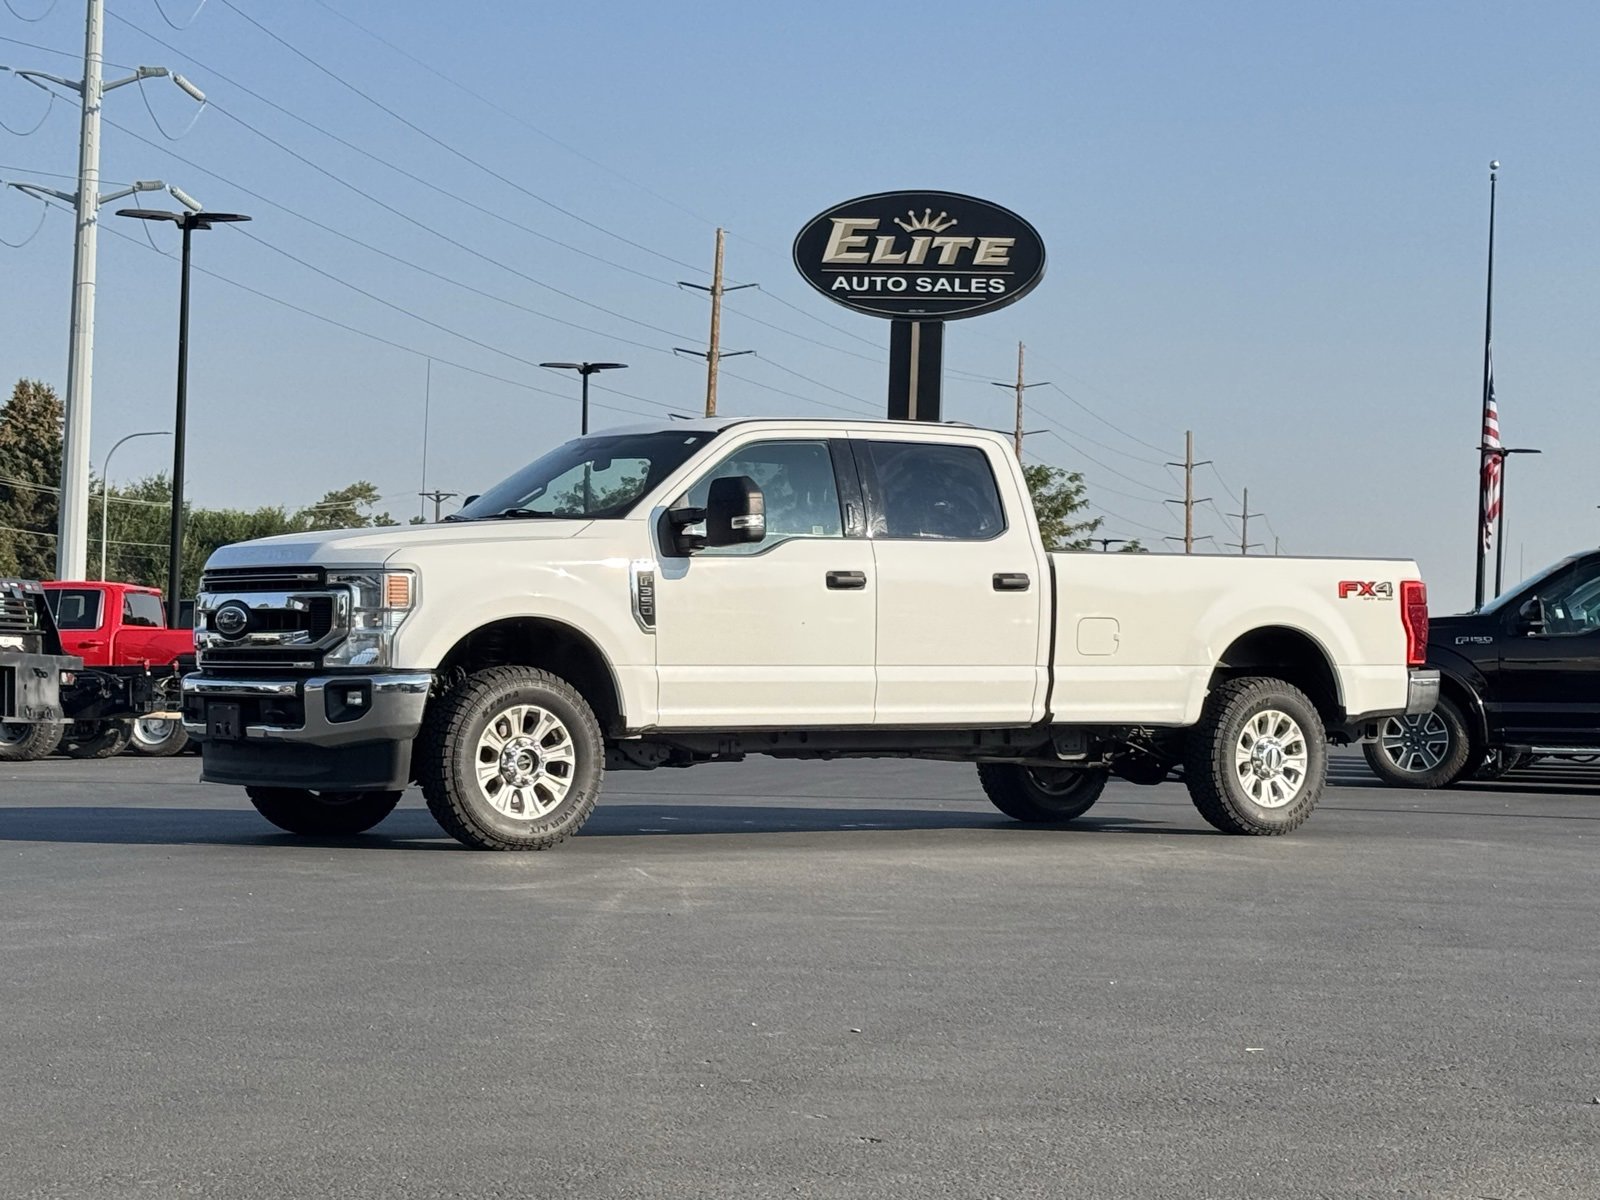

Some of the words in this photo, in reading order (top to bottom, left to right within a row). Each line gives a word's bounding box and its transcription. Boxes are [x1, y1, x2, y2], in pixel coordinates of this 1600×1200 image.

[821, 217, 1016, 266] ELITE
[831, 276, 908, 292] AUTO
[915, 278, 1006, 294] SALES
[1338, 580, 1393, 598] FX4
[482, 690, 519, 718] KENDA
[550, 790, 586, 828] KLEVER
[1288, 790, 1312, 817] KENDA
